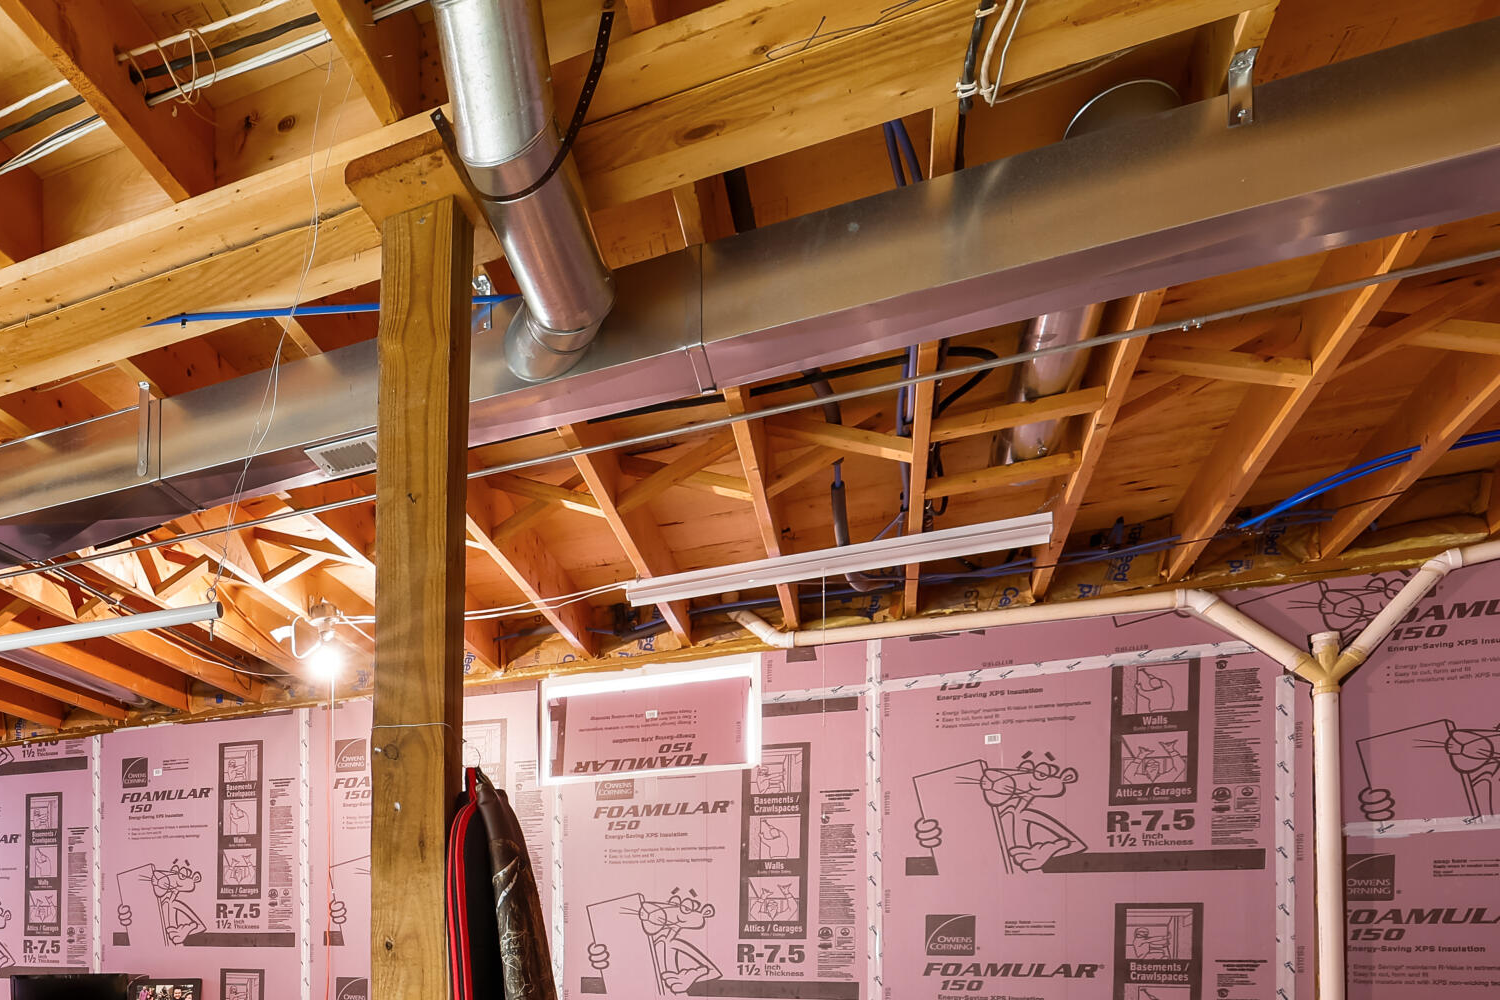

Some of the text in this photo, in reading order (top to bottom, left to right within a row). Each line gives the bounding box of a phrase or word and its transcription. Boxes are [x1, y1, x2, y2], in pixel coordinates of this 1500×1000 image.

[1391, 624, 1448, 641] 150
[1142, 715, 1169, 726] Walls
[658, 742, 693, 754] 150
[573, 753, 708, 774] FOAMULAR
[120, 787, 211, 804] FOAMULAR
[345, 790, 372, 800] 150
[1115, 788, 1143, 798] Attics
[1153, 785, 1192, 797] Garages
[753, 795, 794, 805] Basements
[130, 803, 153, 813] 150
[593, 800, 730, 819] FOAMULAR
[753, 803, 800, 814] Crawlspaces
[607, 820, 641, 831] 150
[1106, 809, 1195, 833] R-7.5
[1142, 838, 1194, 847] Thickness
[764, 861, 785, 871] Walls
[215, 903, 261, 919] R-7.5
[1347, 907, 1500, 925] OAMUL
[743, 923, 766, 933] Attics
[773, 924, 803, 934] Garages
[937, 935, 973, 943] OWENS
[1349, 928, 1406, 941] 150
[23, 939, 61, 954] R-7.5
[929, 942, 973, 951] CORNING
[736, 943, 806, 964] R-7.5
[923, 962, 1099, 979] FOAMULAR
[1130, 962, 1182, 972] Basements
[764, 969, 805, 977] Thickness
[1130, 971, 1189, 982] Crawlspaces
[941, 980, 984, 991] 150
